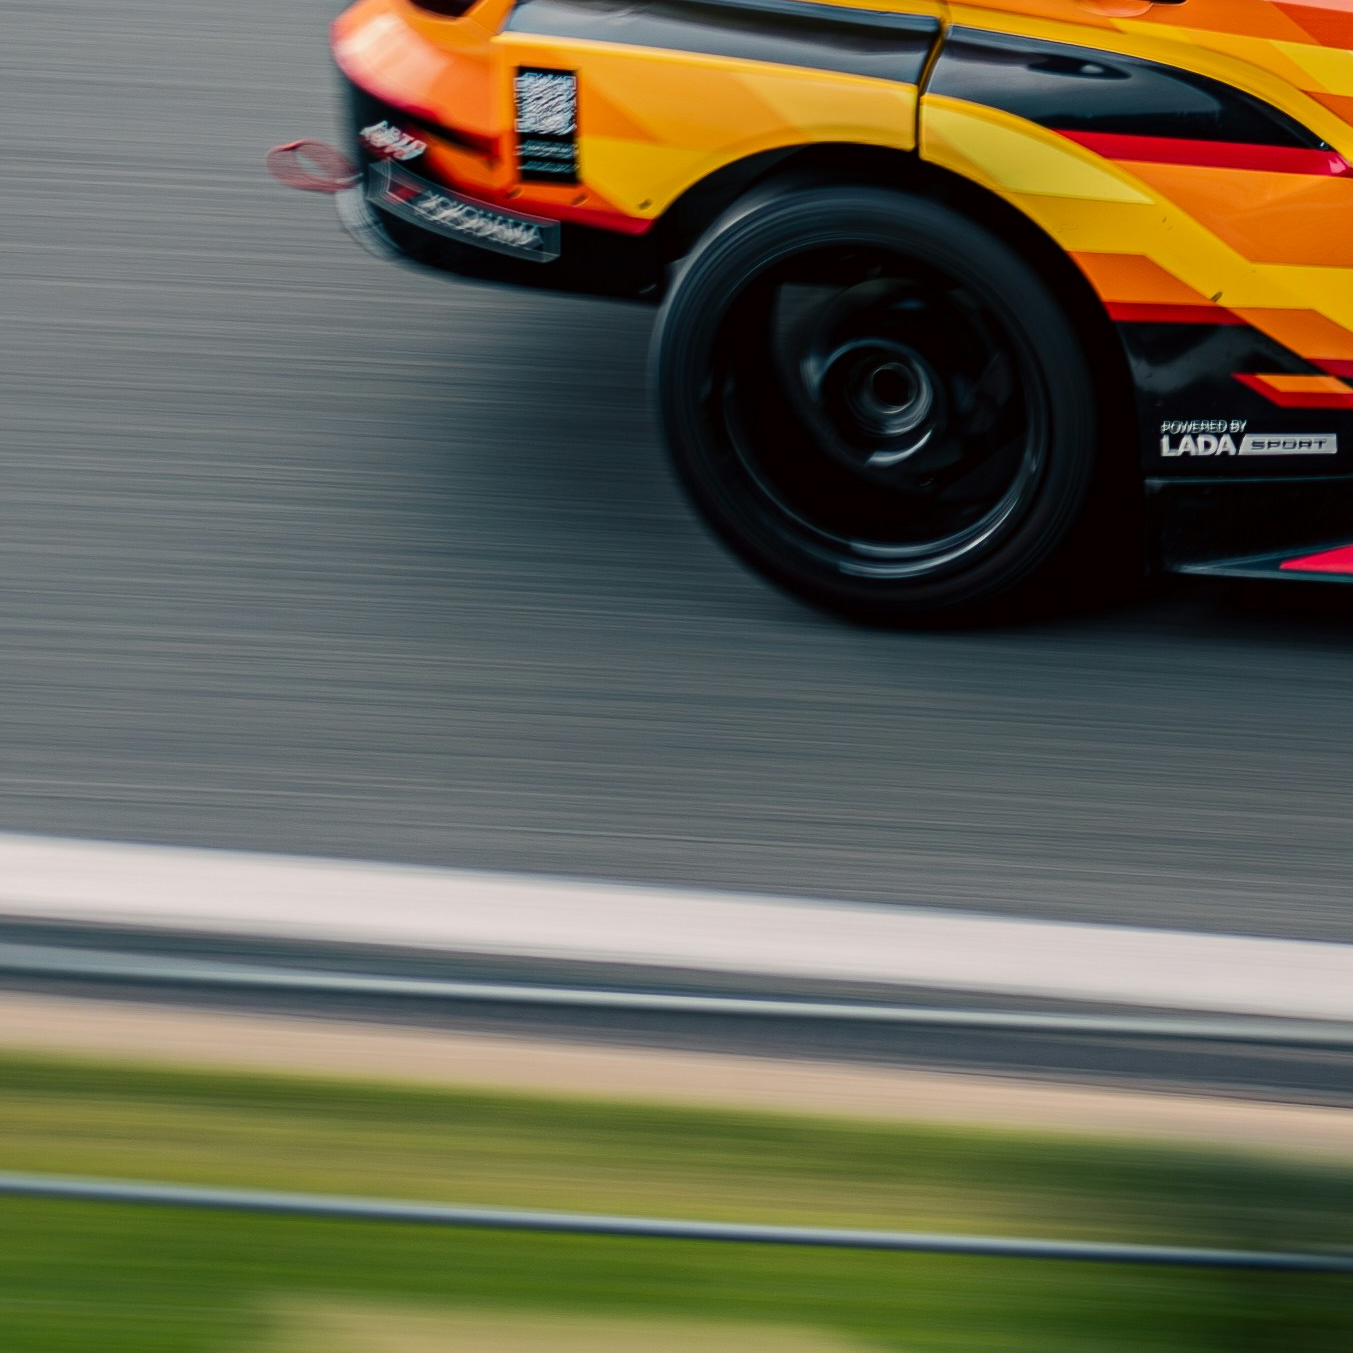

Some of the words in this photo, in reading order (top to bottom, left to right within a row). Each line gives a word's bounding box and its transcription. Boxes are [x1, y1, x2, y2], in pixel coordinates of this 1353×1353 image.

[1161, 420, 1228, 434] POWERED
[1229, 419, 1248, 433] BY
[1160, 434, 1237, 457] LADA
[1251, 438, 1328, 450] SPORT
